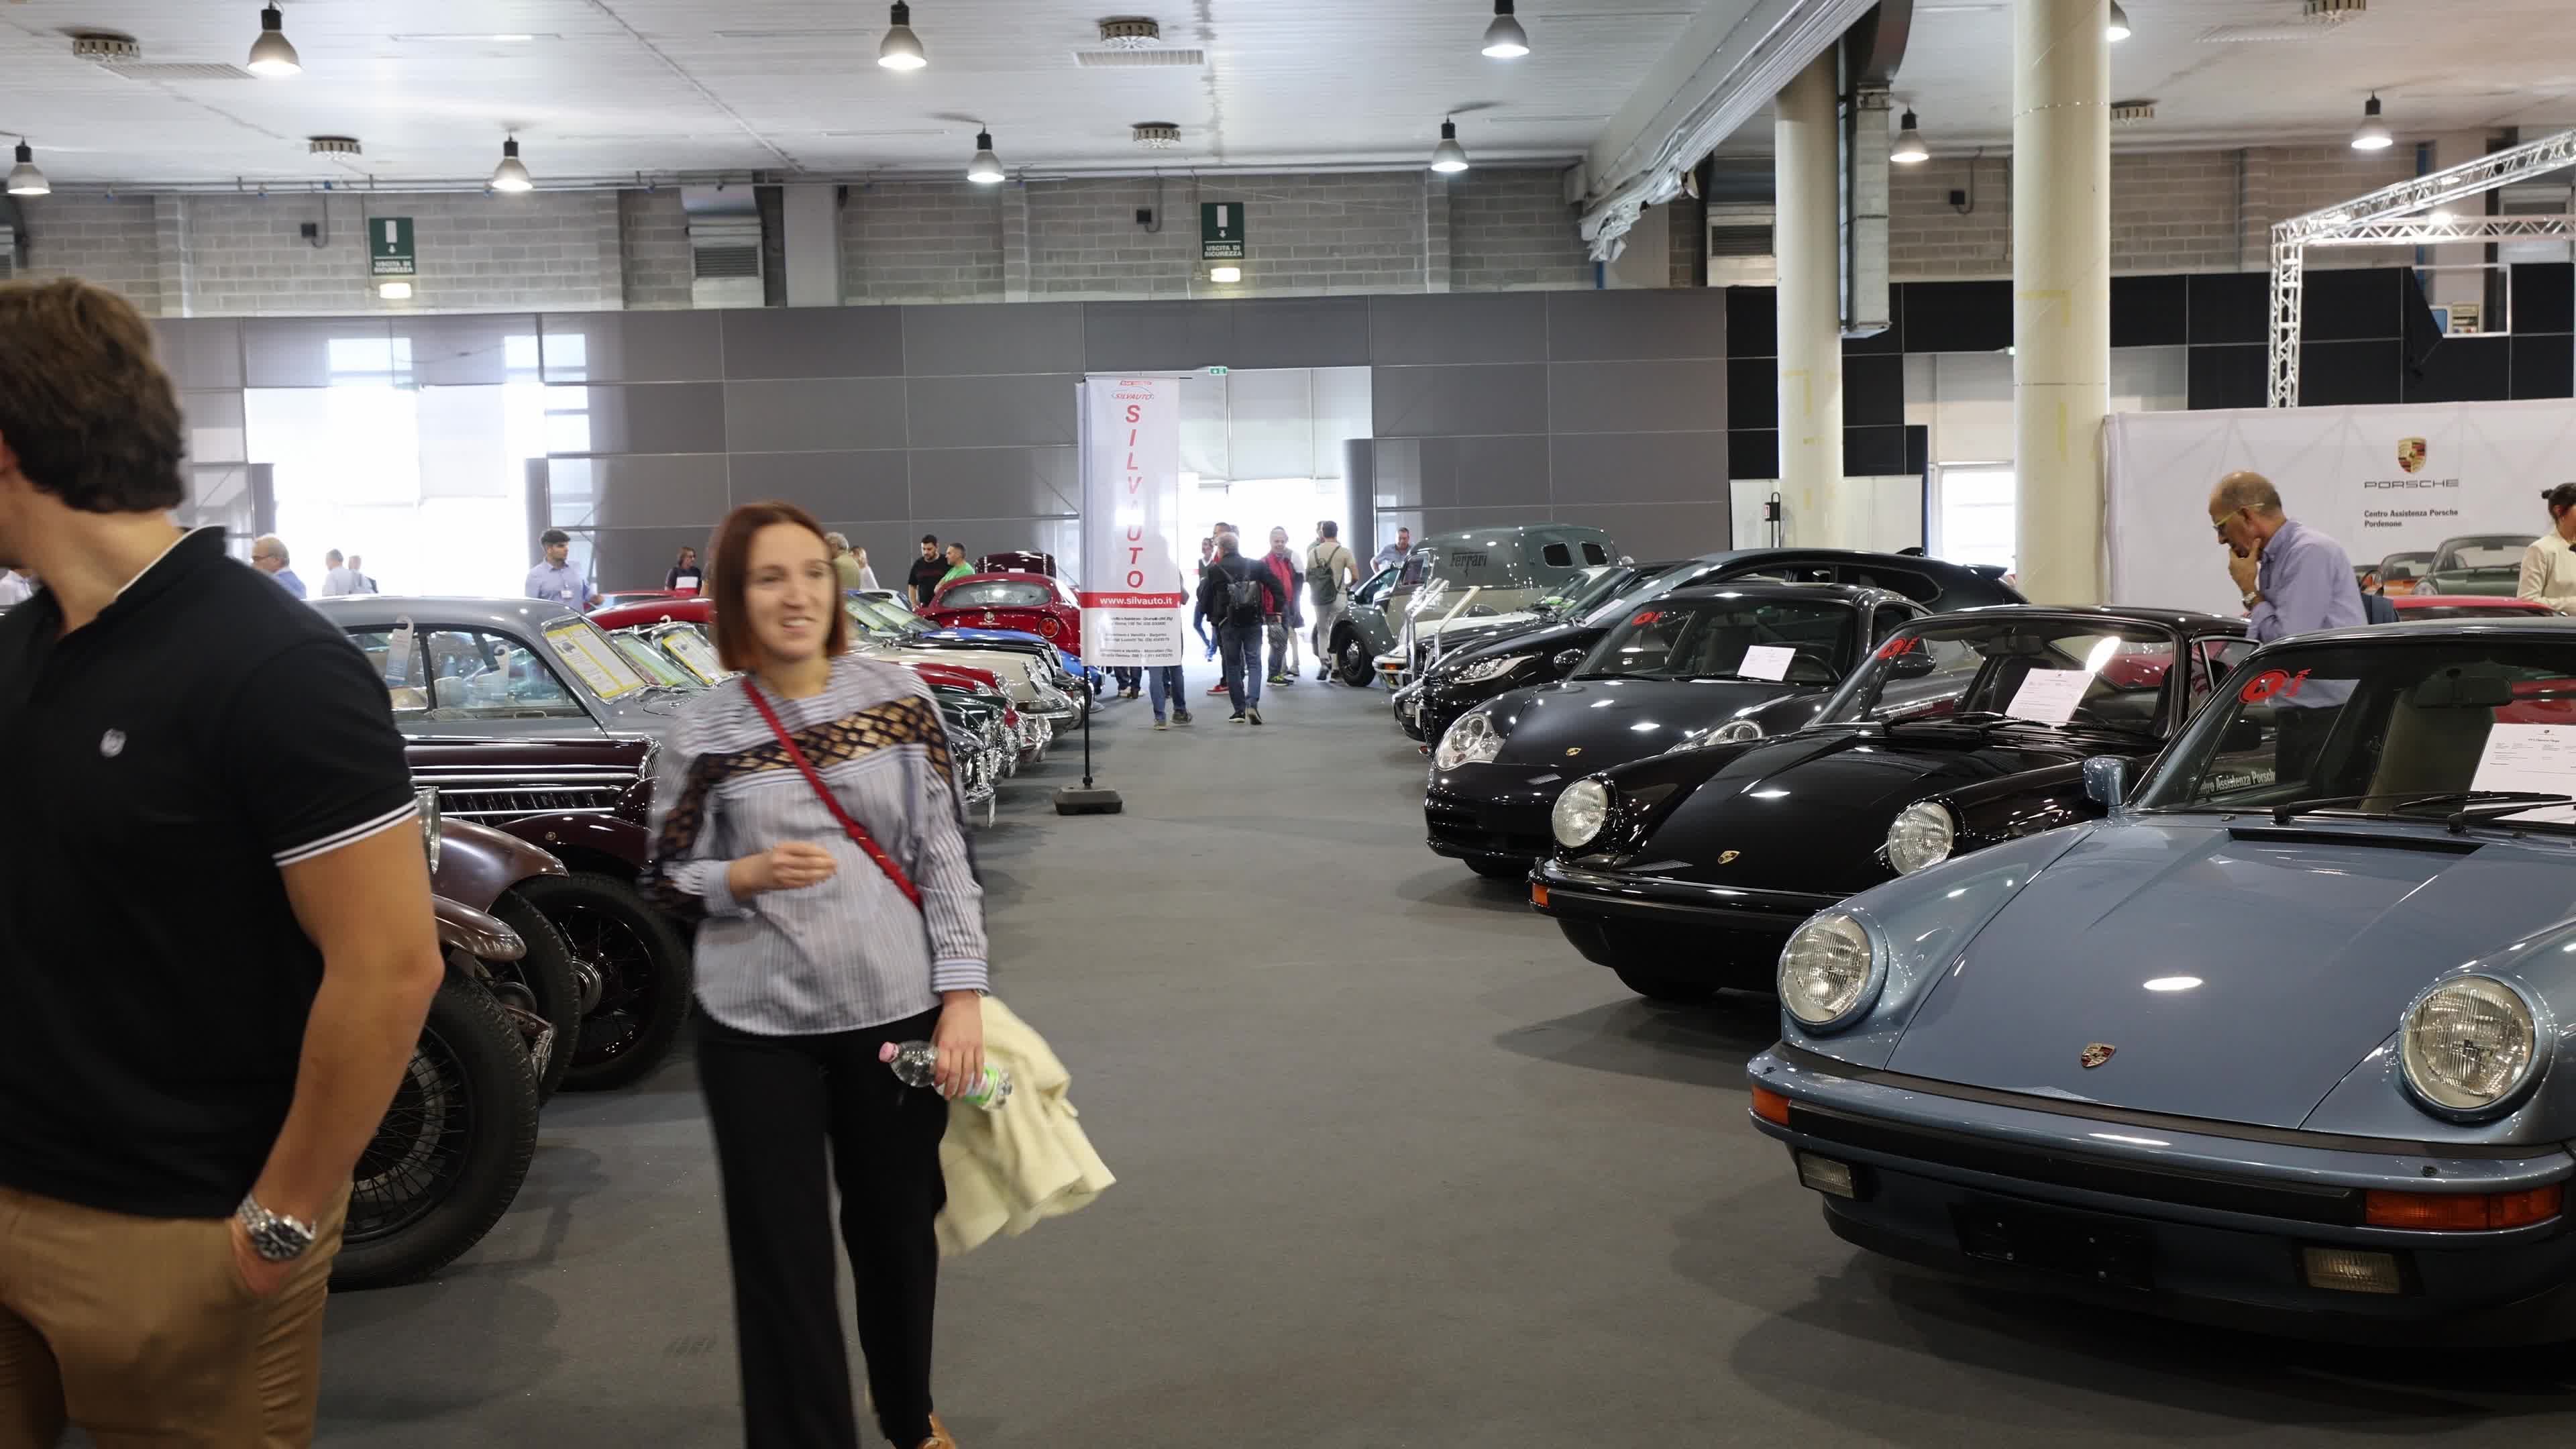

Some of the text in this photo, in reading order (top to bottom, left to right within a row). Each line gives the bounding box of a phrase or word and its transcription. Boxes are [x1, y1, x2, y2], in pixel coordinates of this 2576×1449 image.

[2364, 479, 2459, 489] PORSCHE
[1126, 404, 1144, 589] SILVUTO
[2390, 509, 2427, 517] Assistenza
[1450, 551, 1487, 572] Ferrari
[1100, 596, 1173, 605] www.silvauto.it
